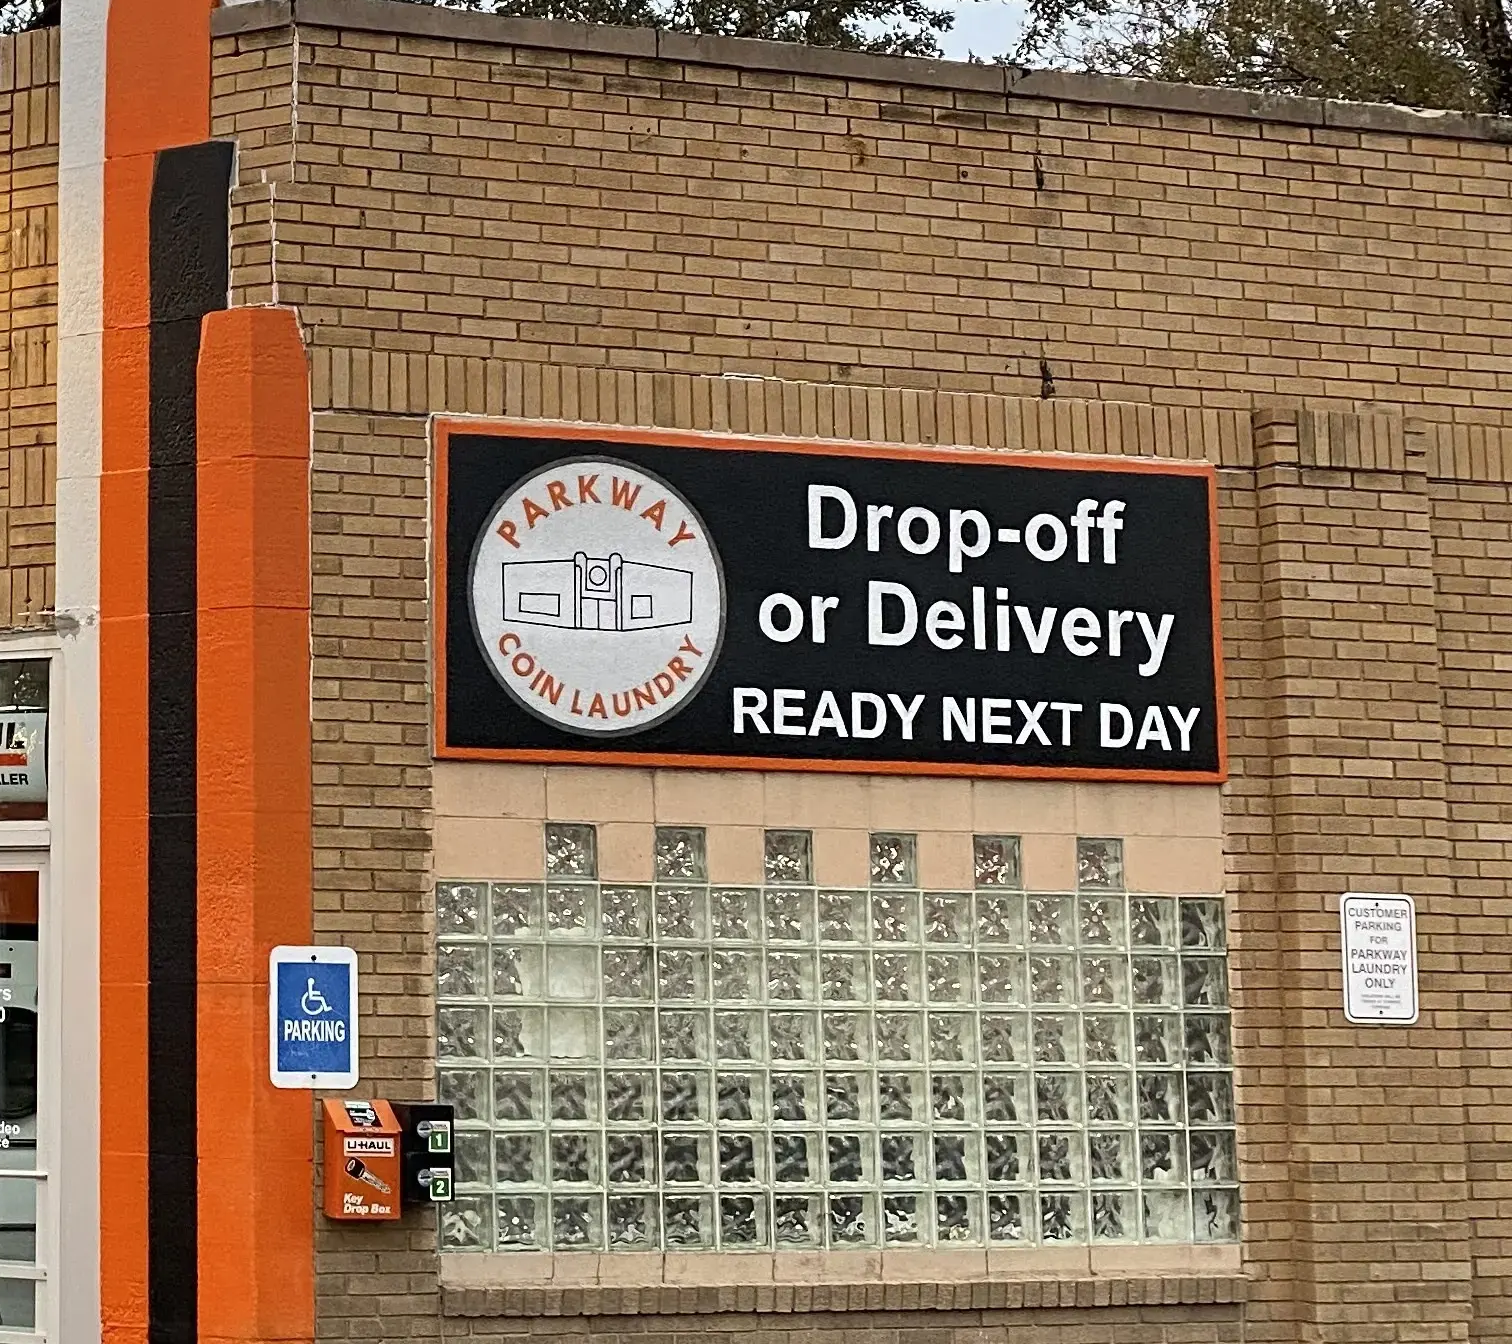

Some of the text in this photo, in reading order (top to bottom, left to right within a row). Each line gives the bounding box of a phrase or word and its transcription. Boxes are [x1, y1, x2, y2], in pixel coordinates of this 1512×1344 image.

[495, 474, 695, 549] PARKWAY
[807, 484, 1126, 573] Drop-off
[758, 581, 1175, 677] or Delivery
[497, 632, 704, 720] COIN LAUNDRY
[732, 686, 1201, 753] READY NEXT DAY
[1348, 907, 1408, 919] CUSTOMER
[1355, 921, 1402, 932] PARKING
[1369, 936, 1388, 944] FOR
[1351, 949, 1407, 960] PARKWAY
[1352, 964, 1407, 974] LAUNDRY
[1365, 978, 1396, 989] ONLY
[284, 1019, 345, 1042] PARKING
[348, 1141, 391, 1149] U-HAUL
[436, 1133, 443, 1147] 1
[436, 1180, 445, 1193] 2
[343, 1193, 364, 1205] Key
[343, 1203, 391, 1215] Drop Box
